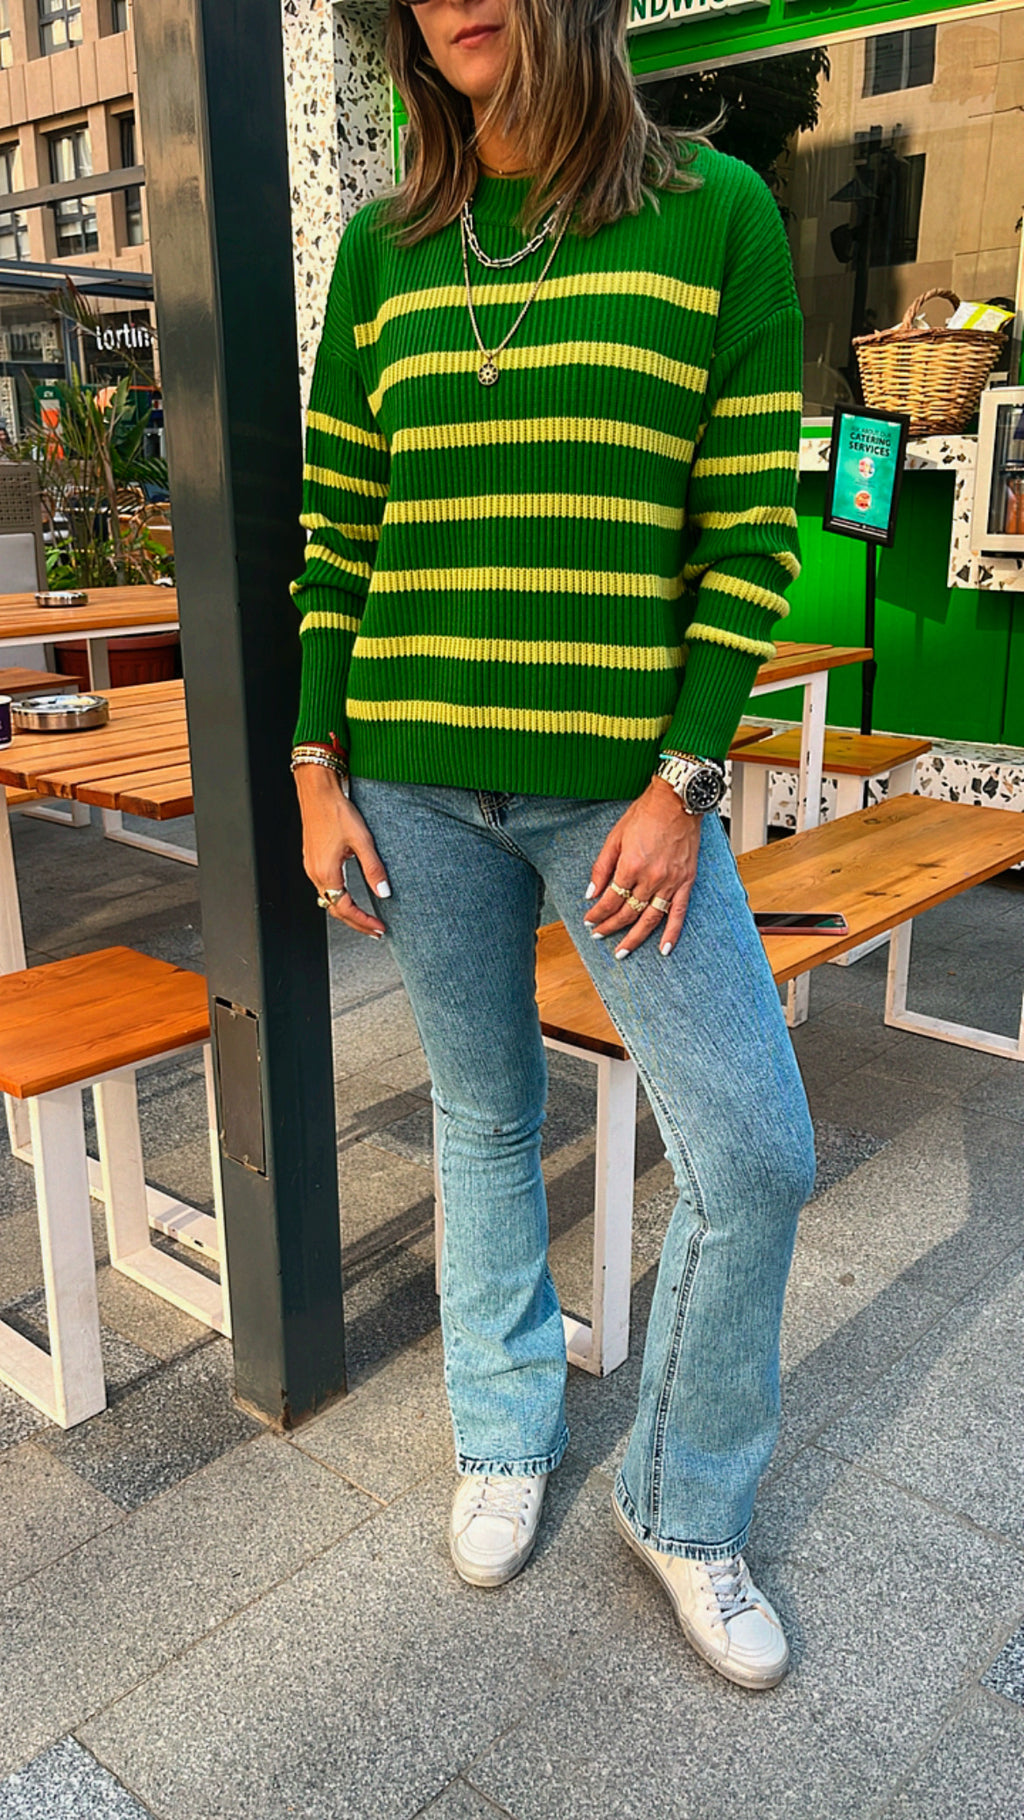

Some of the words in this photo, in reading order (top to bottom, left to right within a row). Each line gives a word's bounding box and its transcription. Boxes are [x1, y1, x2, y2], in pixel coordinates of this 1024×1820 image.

[96, 323, 154, 350] tortin
[850, 432, 891, 447] CATERING
[849, 441, 890, 457] SERVICES
